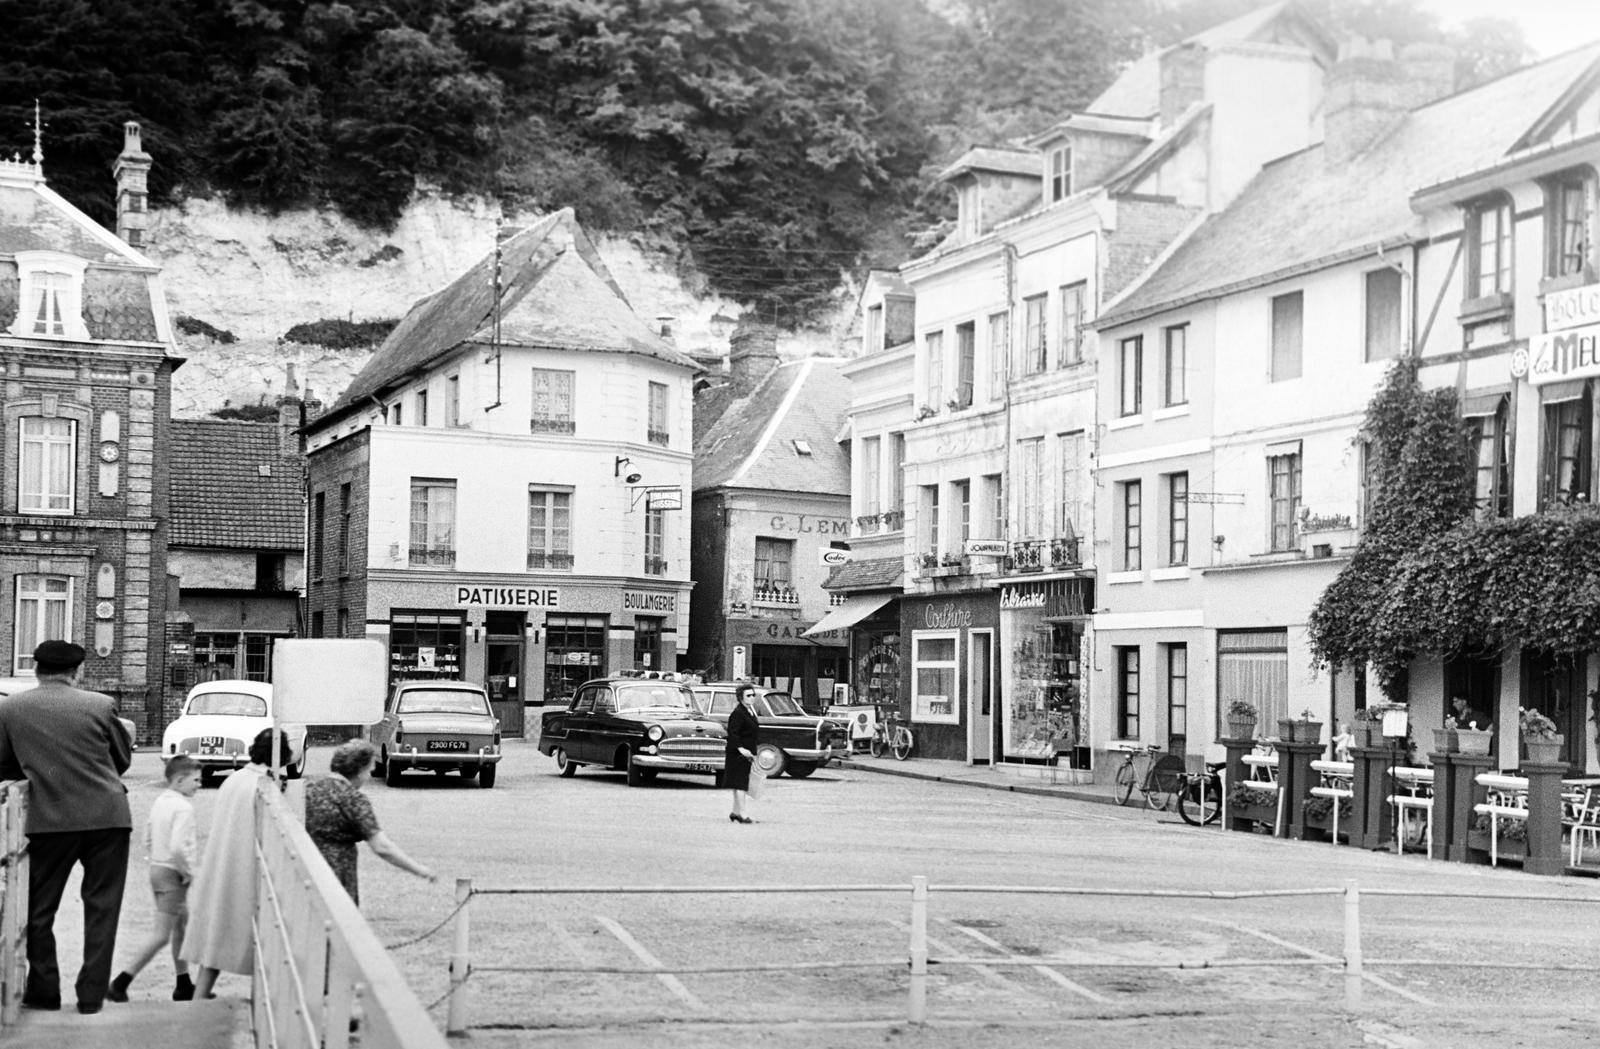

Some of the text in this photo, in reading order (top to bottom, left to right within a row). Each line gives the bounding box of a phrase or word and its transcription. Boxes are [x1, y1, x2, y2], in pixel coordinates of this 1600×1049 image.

[458, 587, 557, 606] PATISSERIE
[624, 592, 674, 612] BOULANGERIE
[430, 741, 448, 749] 2900
